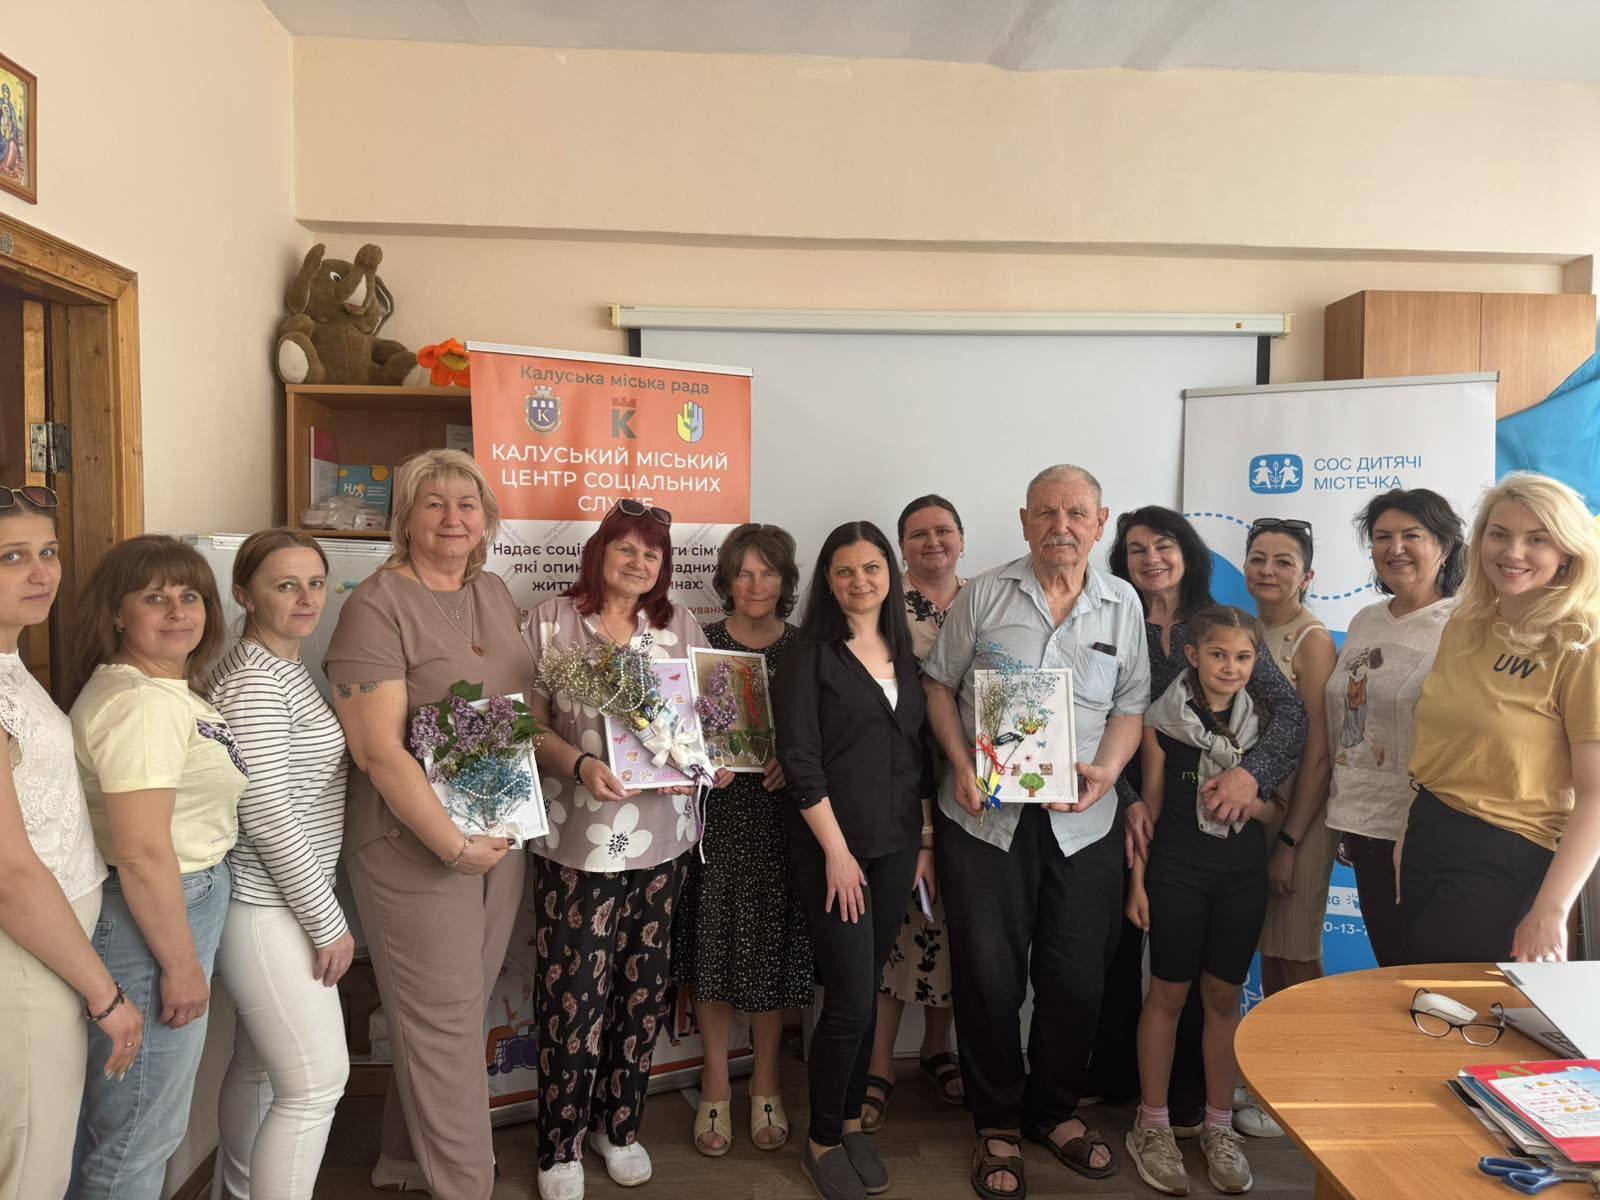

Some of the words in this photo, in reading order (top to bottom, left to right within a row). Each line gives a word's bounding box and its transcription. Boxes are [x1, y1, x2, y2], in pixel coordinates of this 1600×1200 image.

[520, 364, 605, 386] Калуська
[610, 373, 666, 390] міська
[671, 380, 710, 395] рада
[491, 443, 629, 466] КАЛУСЬКИЙ
[636, 450, 728, 471] МІСЬКИЙ
[1313, 457, 1352, 472] СОС
[1356, 455, 1422, 473] ДИТЯЧІ
[501, 469, 577, 489] ЦЕНТР
[583, 472, 721, 493] СОЦІАЛЬНИХ
[1313, 475, 1402, 491] МІСТЕЧКА
[493, 543, 541, 557] Надає
[546, 543, 583, 557] соці
[514, 560, 538, 573] які
[542, 563, 582, 574] опин
[671, 563, 720, 574] адних
[532, 581, 577, 592] житт
[1492, 653, 1539, 679] UW
